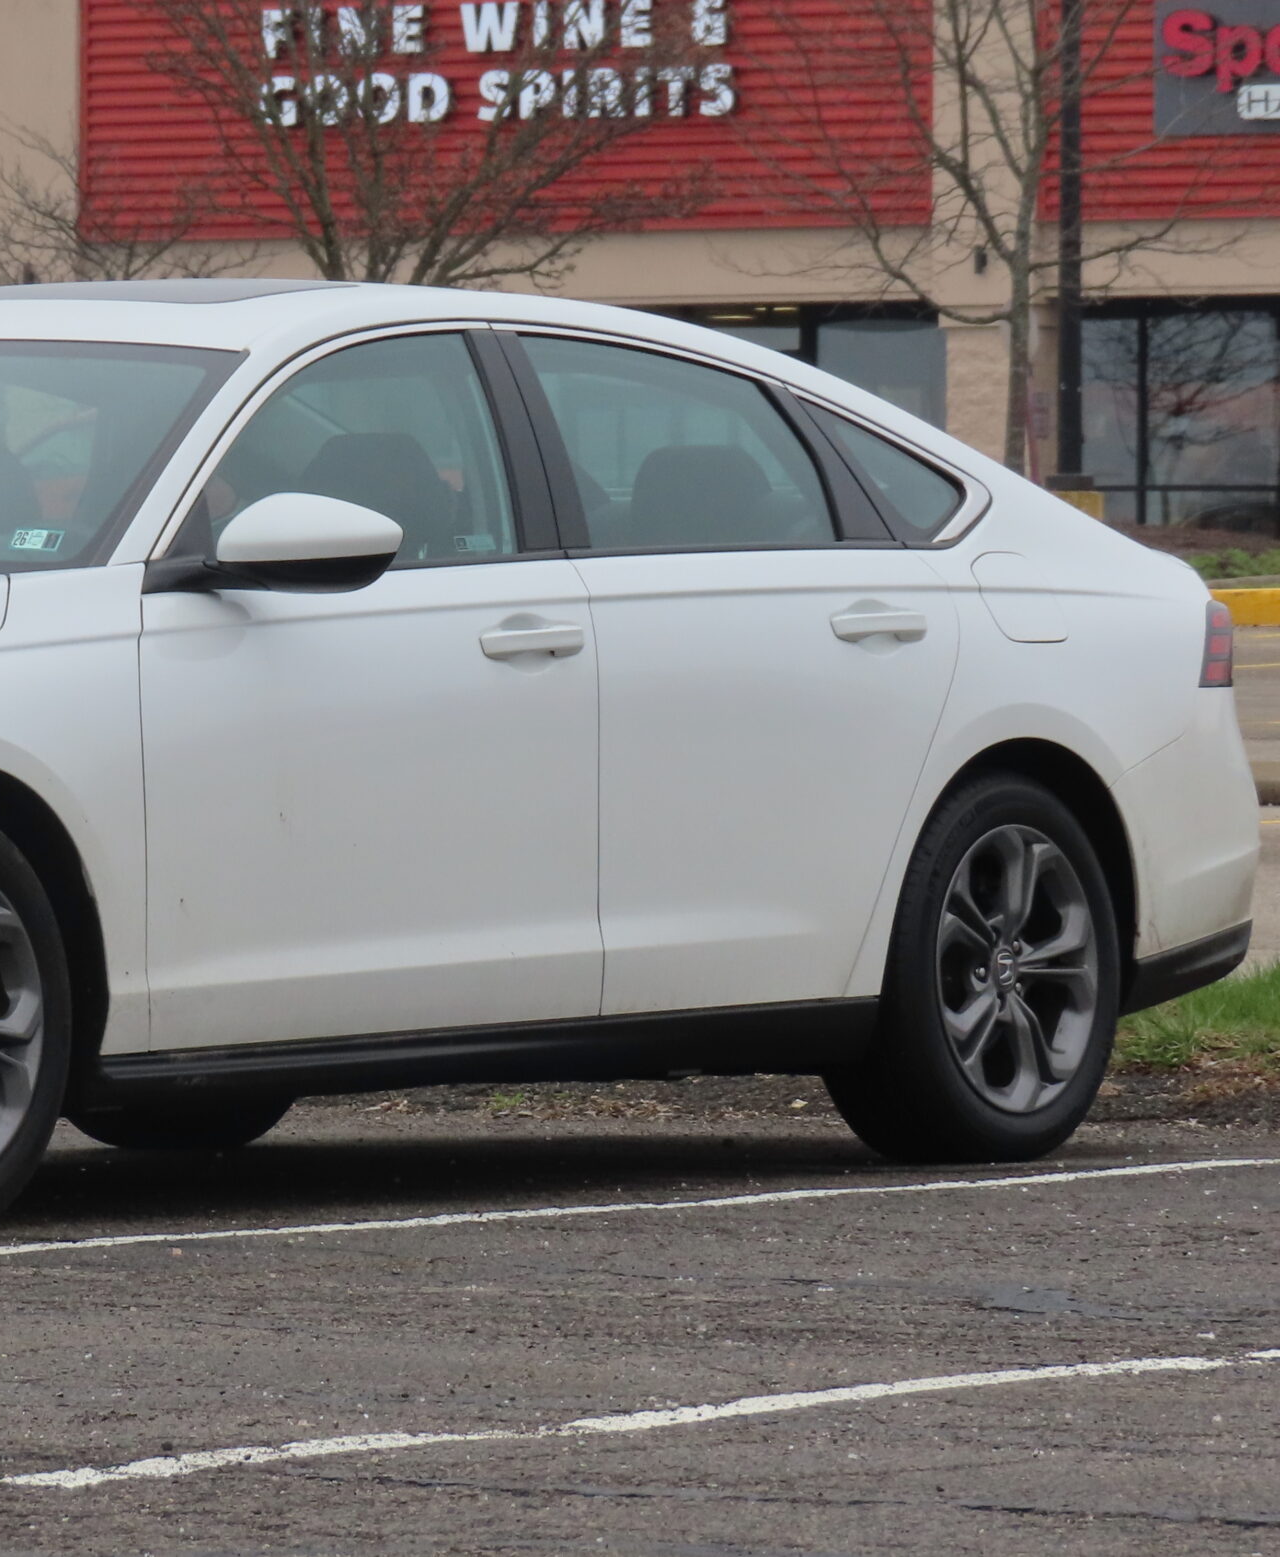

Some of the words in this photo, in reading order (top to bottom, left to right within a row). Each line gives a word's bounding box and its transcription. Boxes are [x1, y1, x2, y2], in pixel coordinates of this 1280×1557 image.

[460, 0, 653, 52] WINE
[477, 63, 735, 121] SPIRITS
[1246, 90, 1280, 113] H
